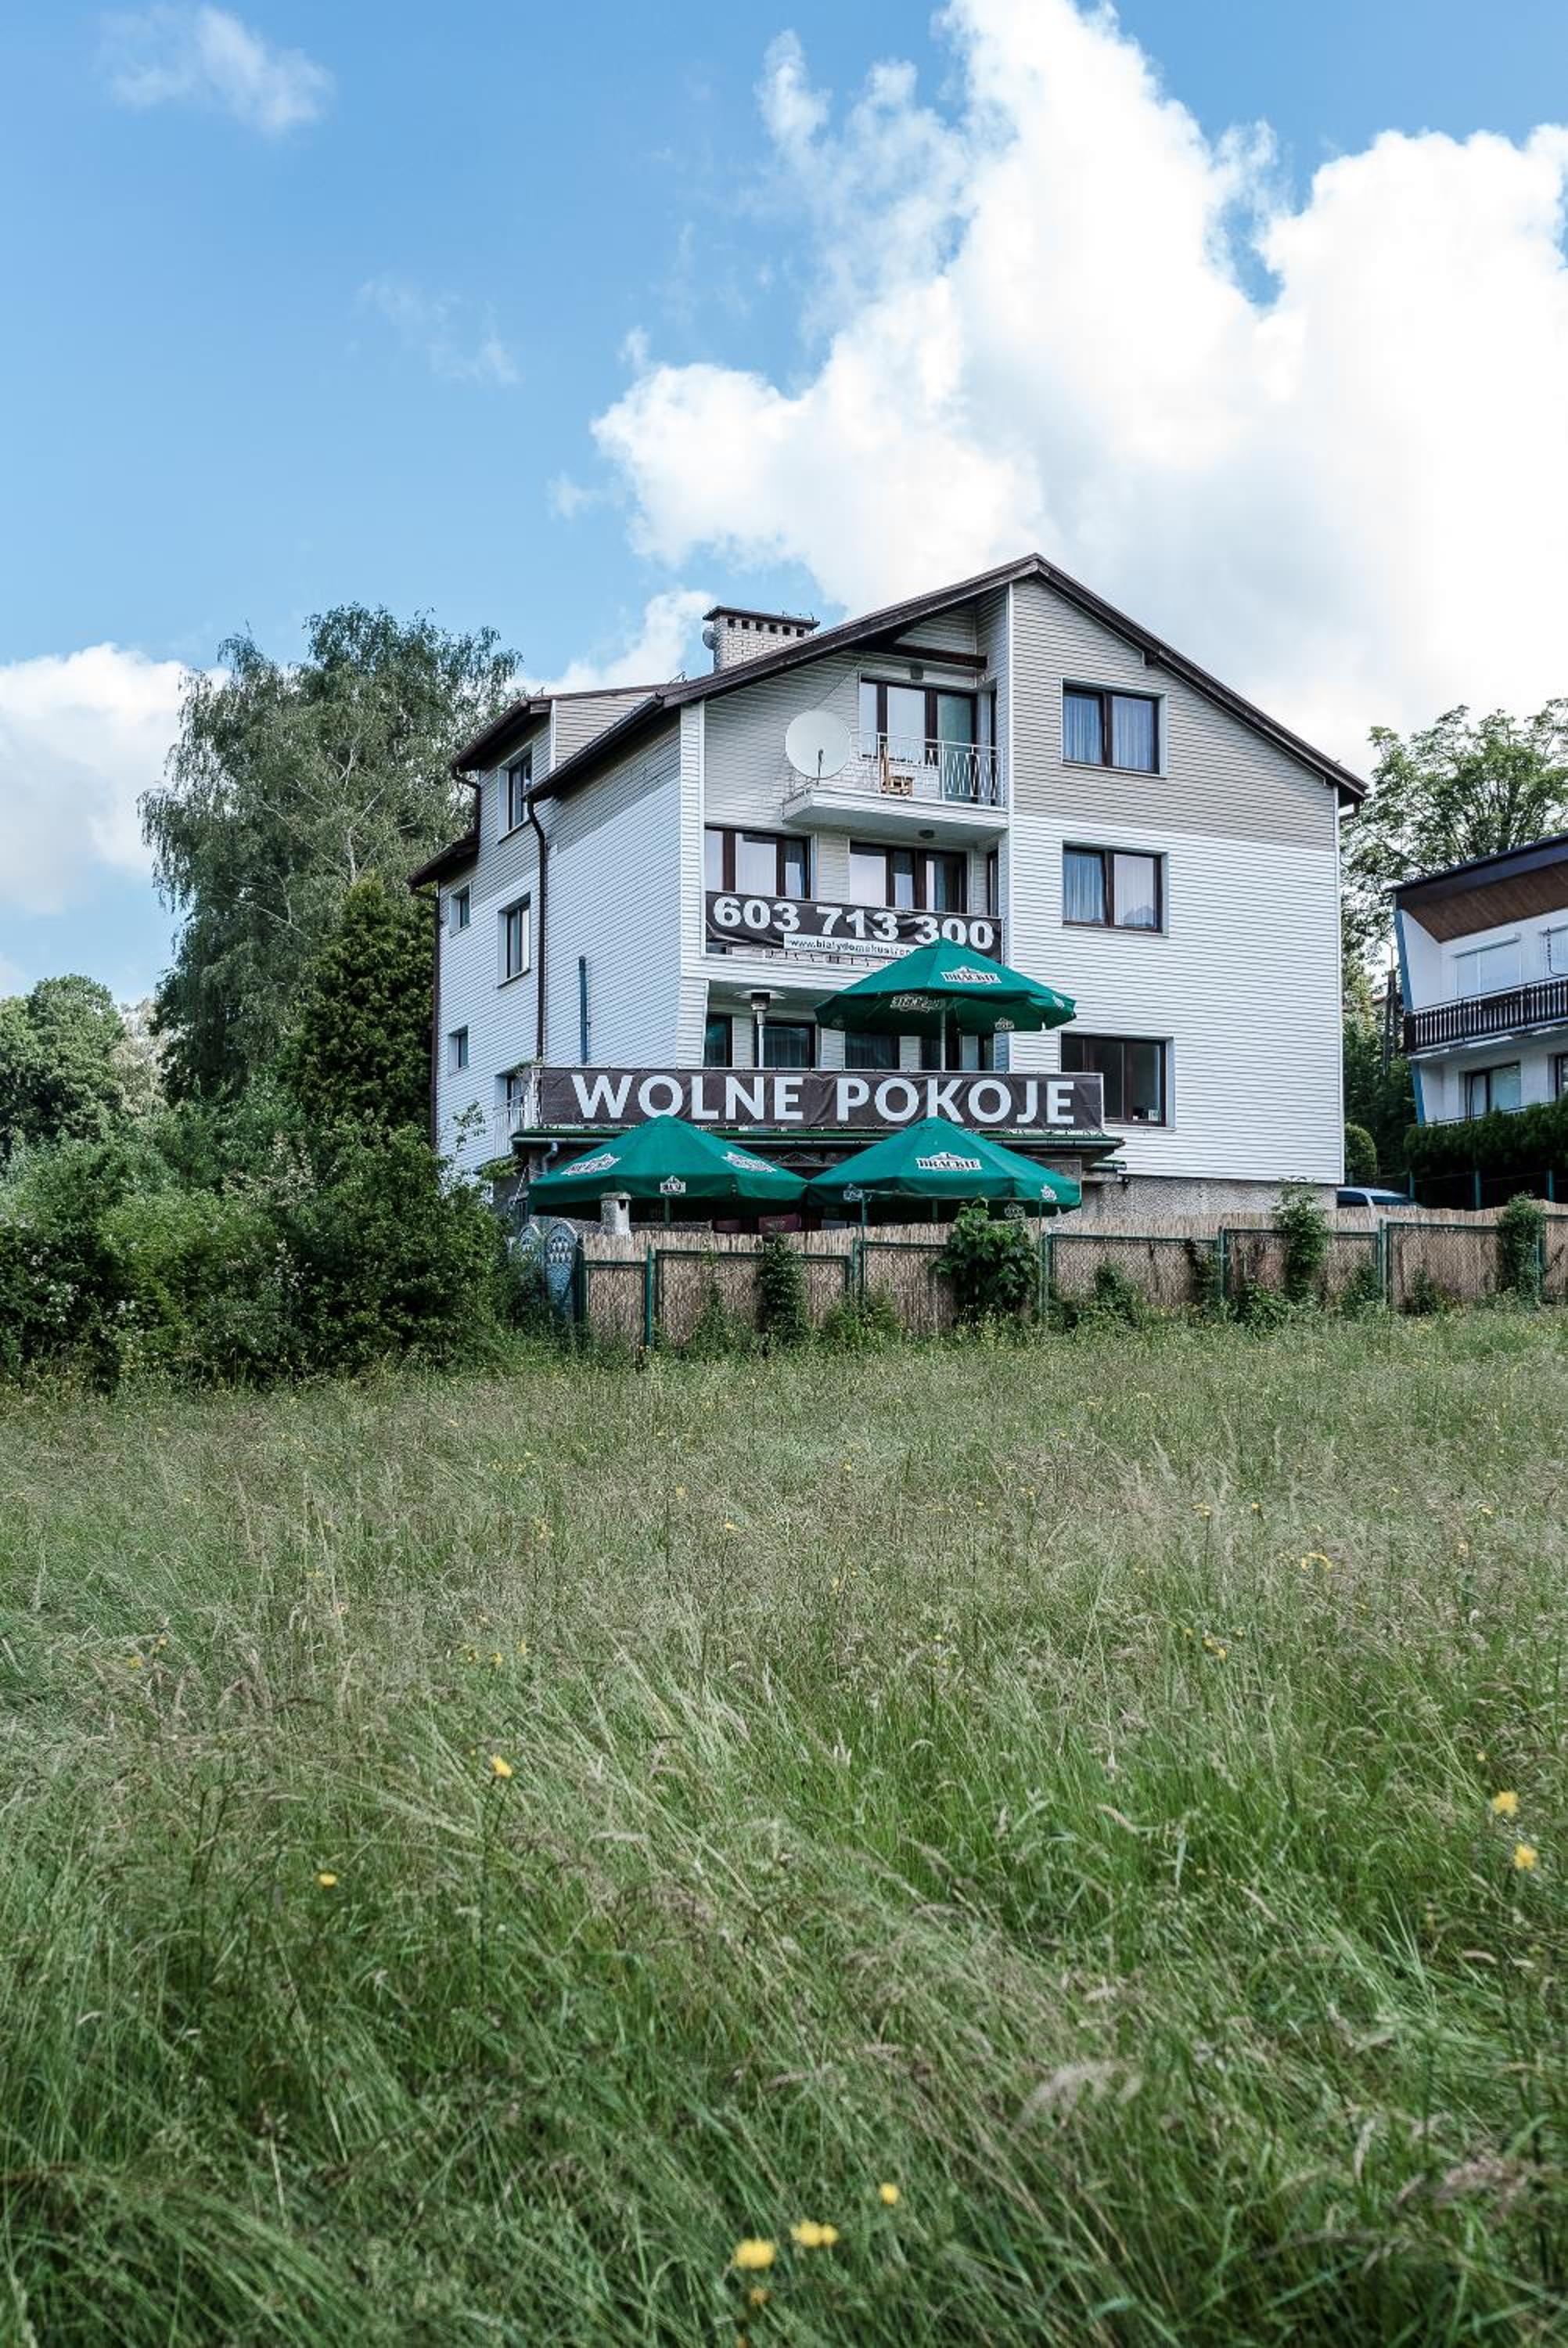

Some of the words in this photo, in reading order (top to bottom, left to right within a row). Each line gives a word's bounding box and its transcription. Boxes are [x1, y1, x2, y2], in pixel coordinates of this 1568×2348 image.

[713, 896, 801, 933] 603
[816, 906, 900, 942] 713
[914, 917, 995, 949] 300
[572, 1075, 804, 1121] WOLNE
[836, 1078, 1075, 1124] POKOJE
